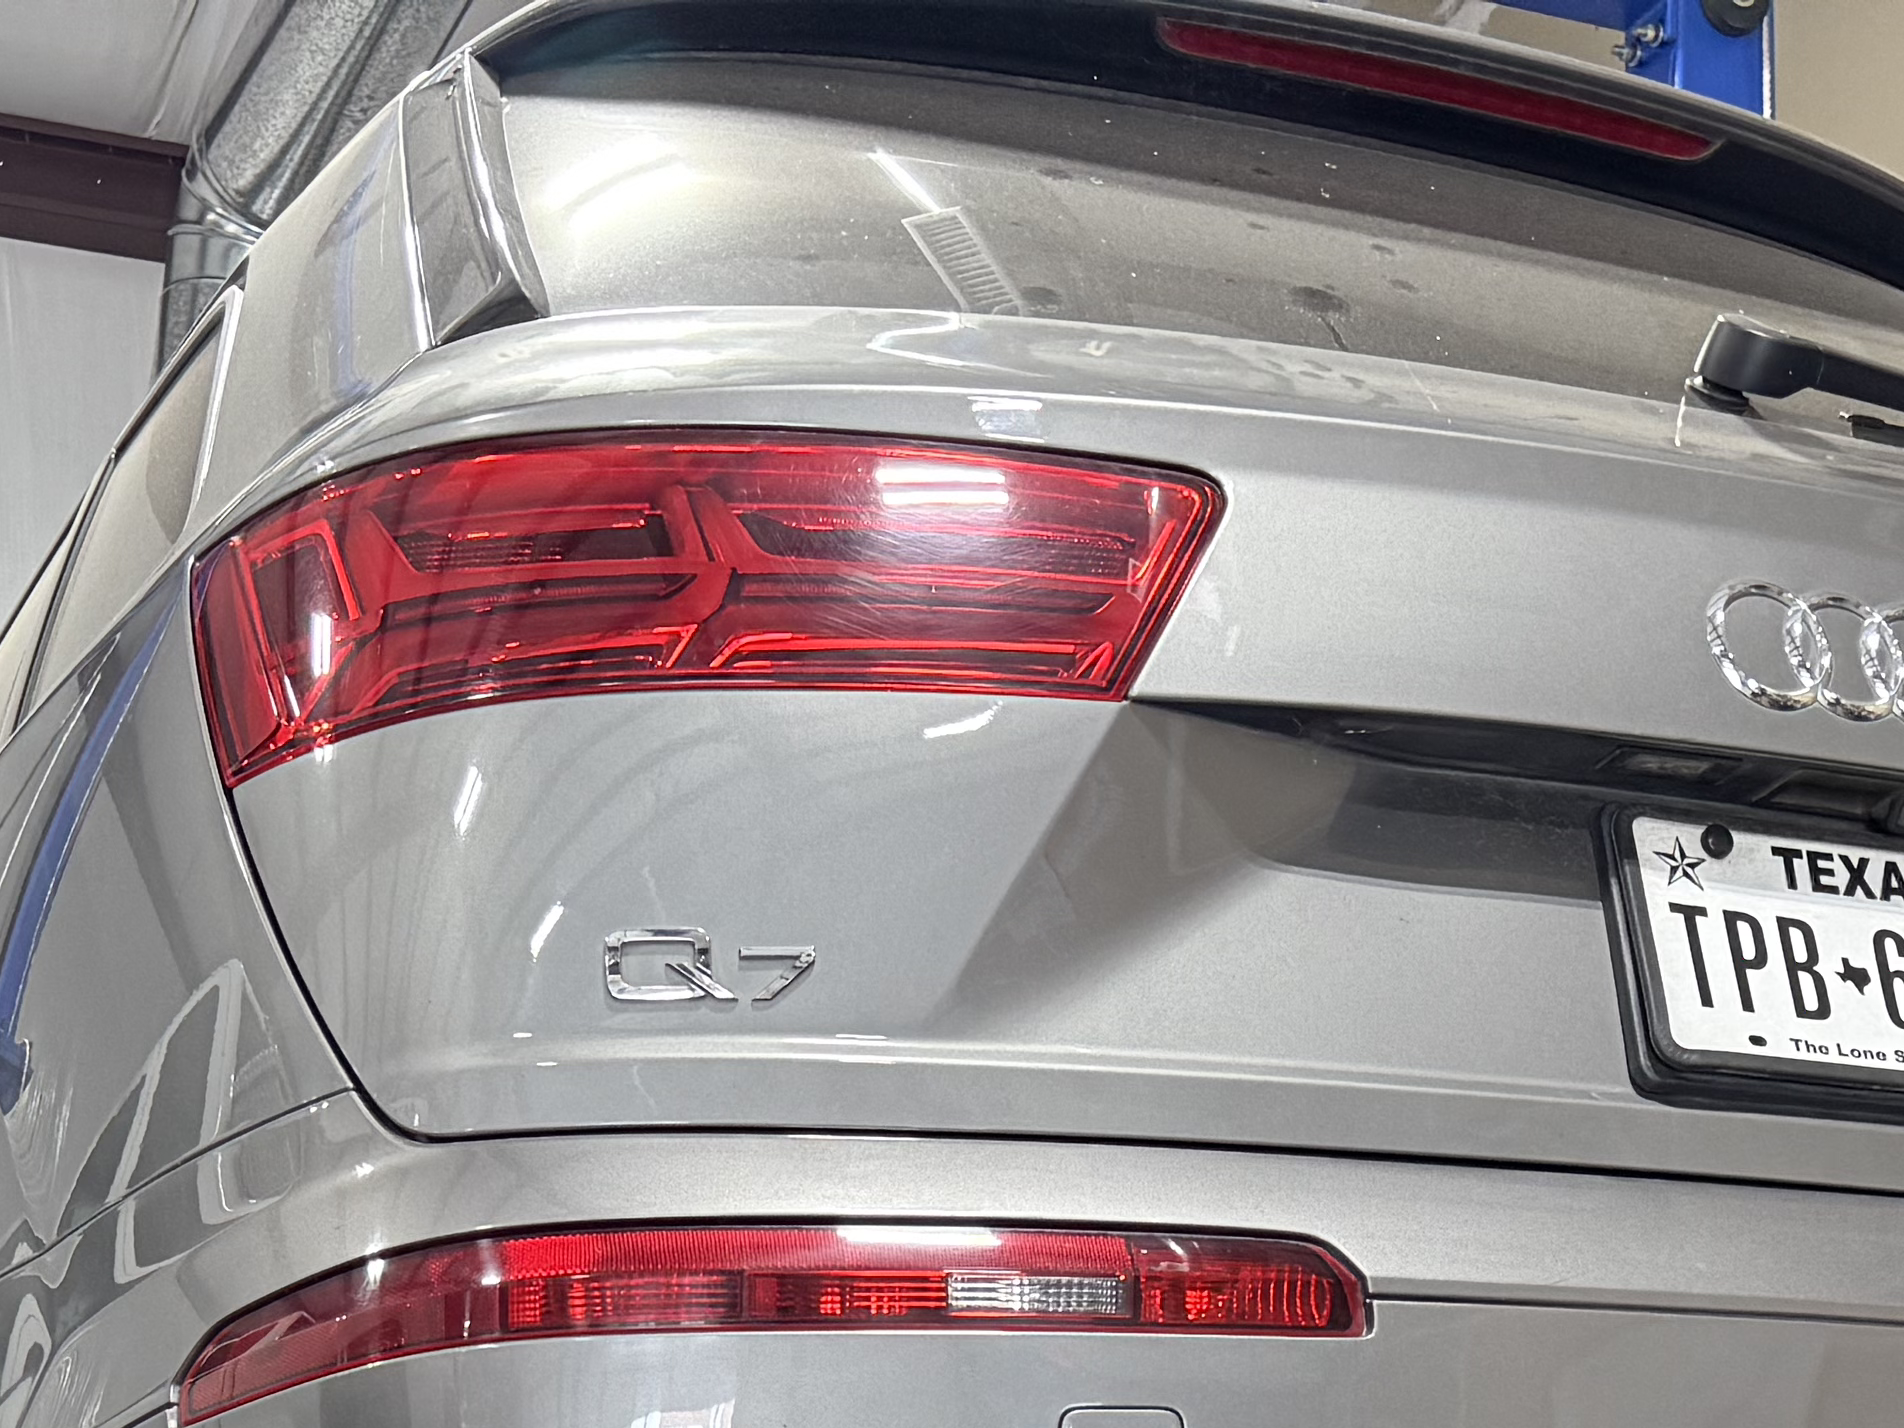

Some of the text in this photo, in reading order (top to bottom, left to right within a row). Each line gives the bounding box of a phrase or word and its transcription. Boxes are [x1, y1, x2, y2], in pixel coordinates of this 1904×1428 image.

[604, 926, 816, 1001] Q7
[1668, 902, 1832, 1020] TPB
[1789, 1037, 1829, 1056] The
[1837, 1042, 1887, 1063] Lone
